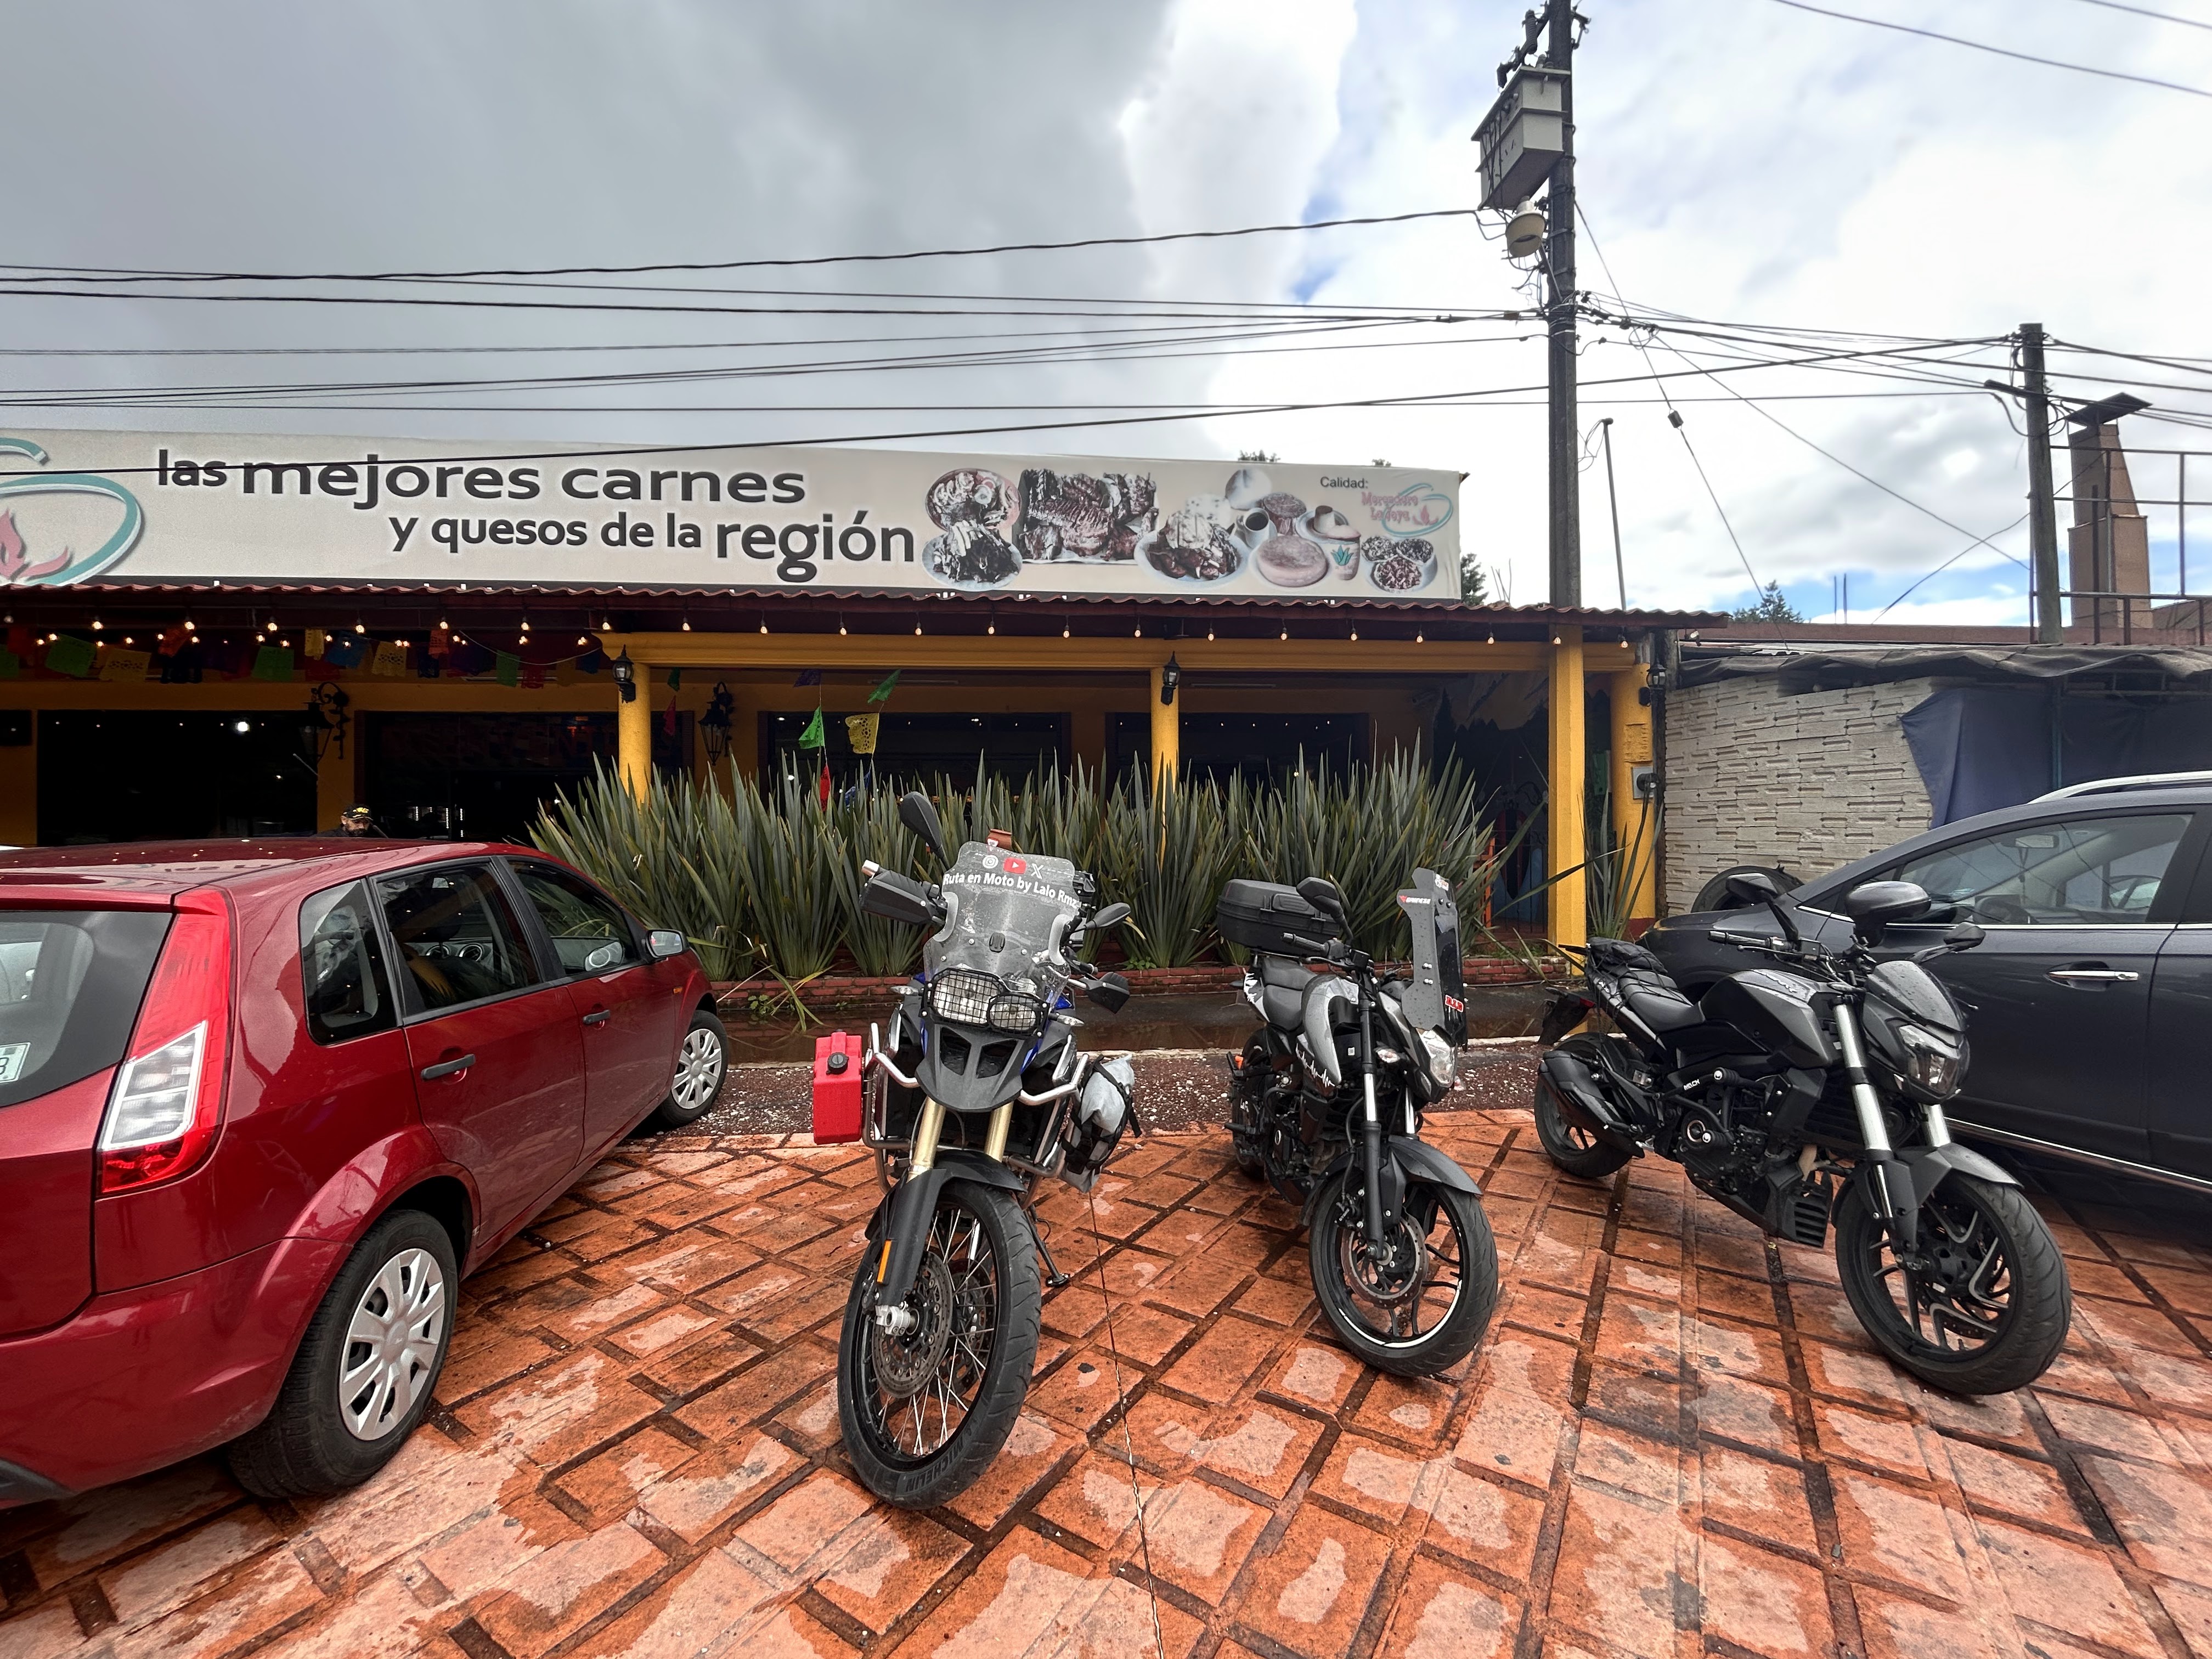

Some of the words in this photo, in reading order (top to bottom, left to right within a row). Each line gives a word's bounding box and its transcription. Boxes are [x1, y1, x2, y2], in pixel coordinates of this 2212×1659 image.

[159, 449, 227, 487] las
[243, 454, 540, 510] mejores
[561, 468, 805, 503] carnes
[1320, 476, 1369, 489] Calidad:
[389, 517, 418, 552] y
[432, 518, 587, 554] quesos
[601, 511, 654, 548] de
[667, 512, 702, 548] la
[717, 510, 914, 583] región
[943, 872, 965, 885] Ruta
[967, 874, 981, 883] en
[983, 872, 1014, 887] Moto
[1017, 876, 1032, 893] by
[1033, 881, 1056, 898] Lalo
[905, 1436, 964, 1492] MICHELIN
